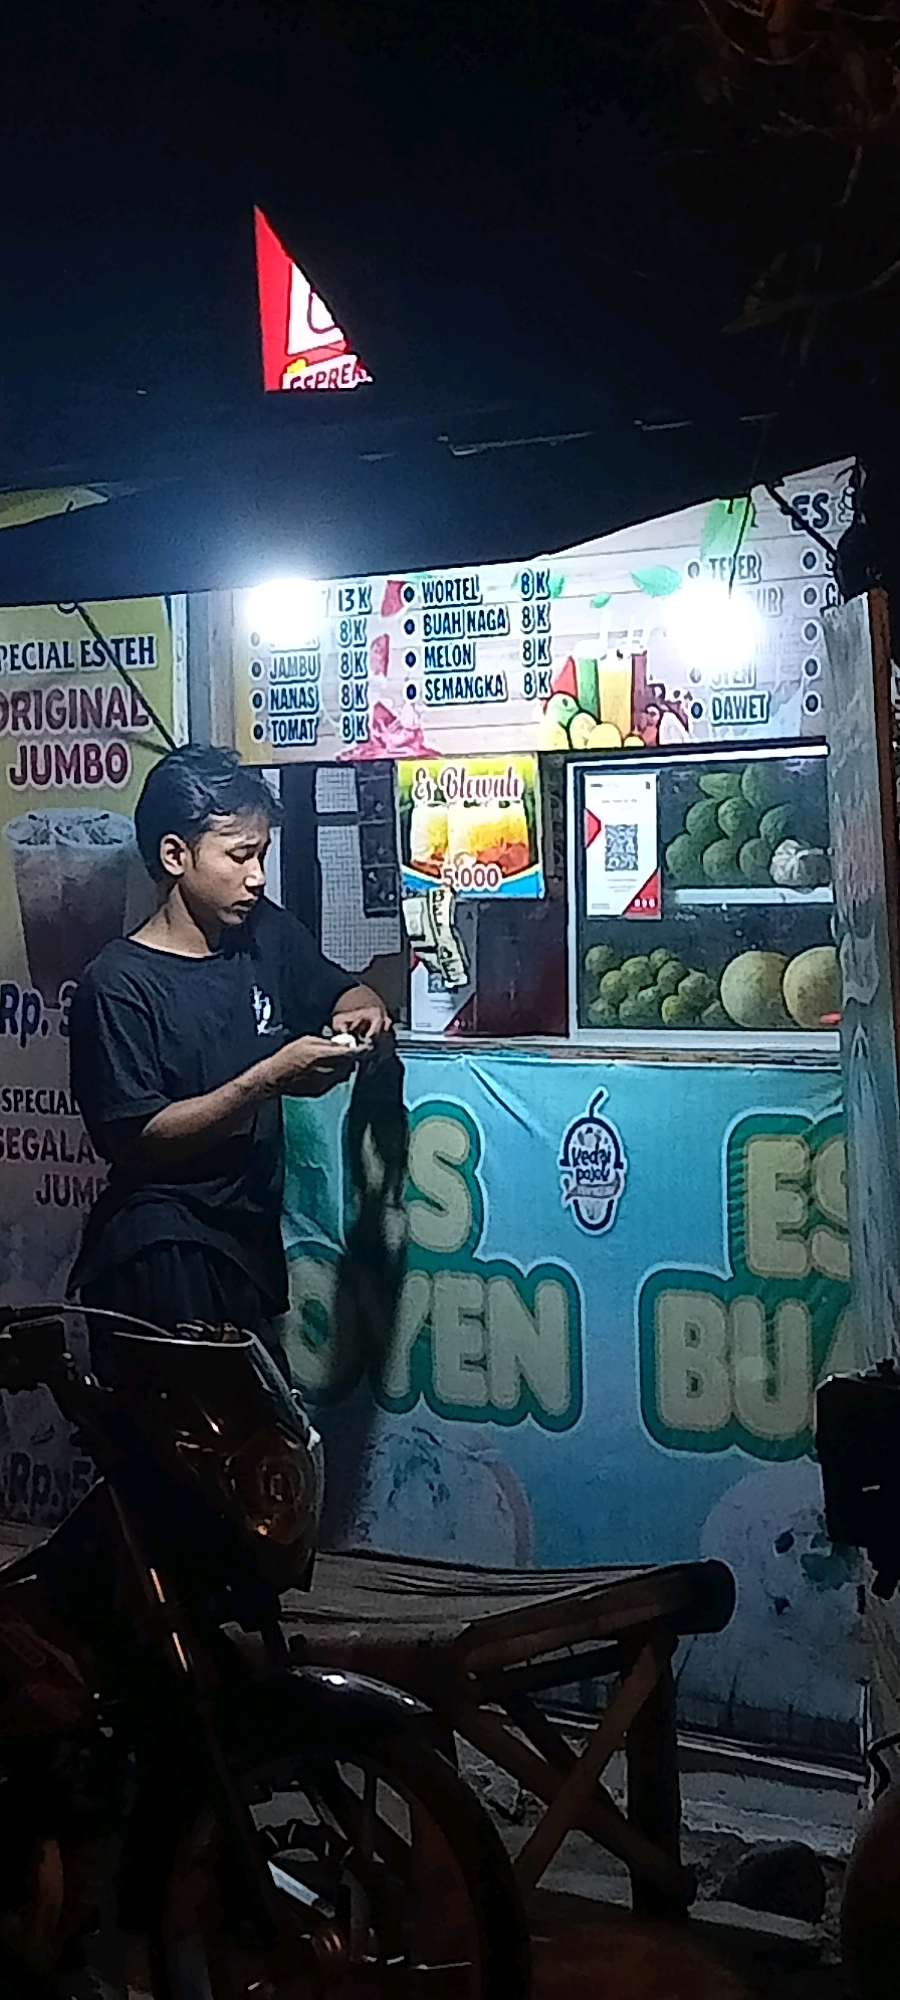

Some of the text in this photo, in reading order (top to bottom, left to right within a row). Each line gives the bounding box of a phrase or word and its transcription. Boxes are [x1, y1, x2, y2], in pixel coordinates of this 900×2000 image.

[792, 492, 829, 529] ES
[422, 577, 479, 603] WORTEL
[423, 612, 461, 636] BUAH
[467, 608, 506, 632] NAGA
[80, 640, 106, 667] ES
[111, 636, 155, 666] TEH
[424, 644, 472, 668] MELON
[270, 655, 317, 679] JAMBU
[270, 686, 315, 712] NANAS
[425, 674, 504, 700] SEMANGKA
[712, 694, 766, 721] DAWET
[272, 719, 315, 741] TOMAT
[10, 743, 128, 786] JUMBO
[0, 984, 48, 1048] Rp.
[2, 1088, 80, 1115] SPECIAL
[654, 1287, 860, 1438] BU
